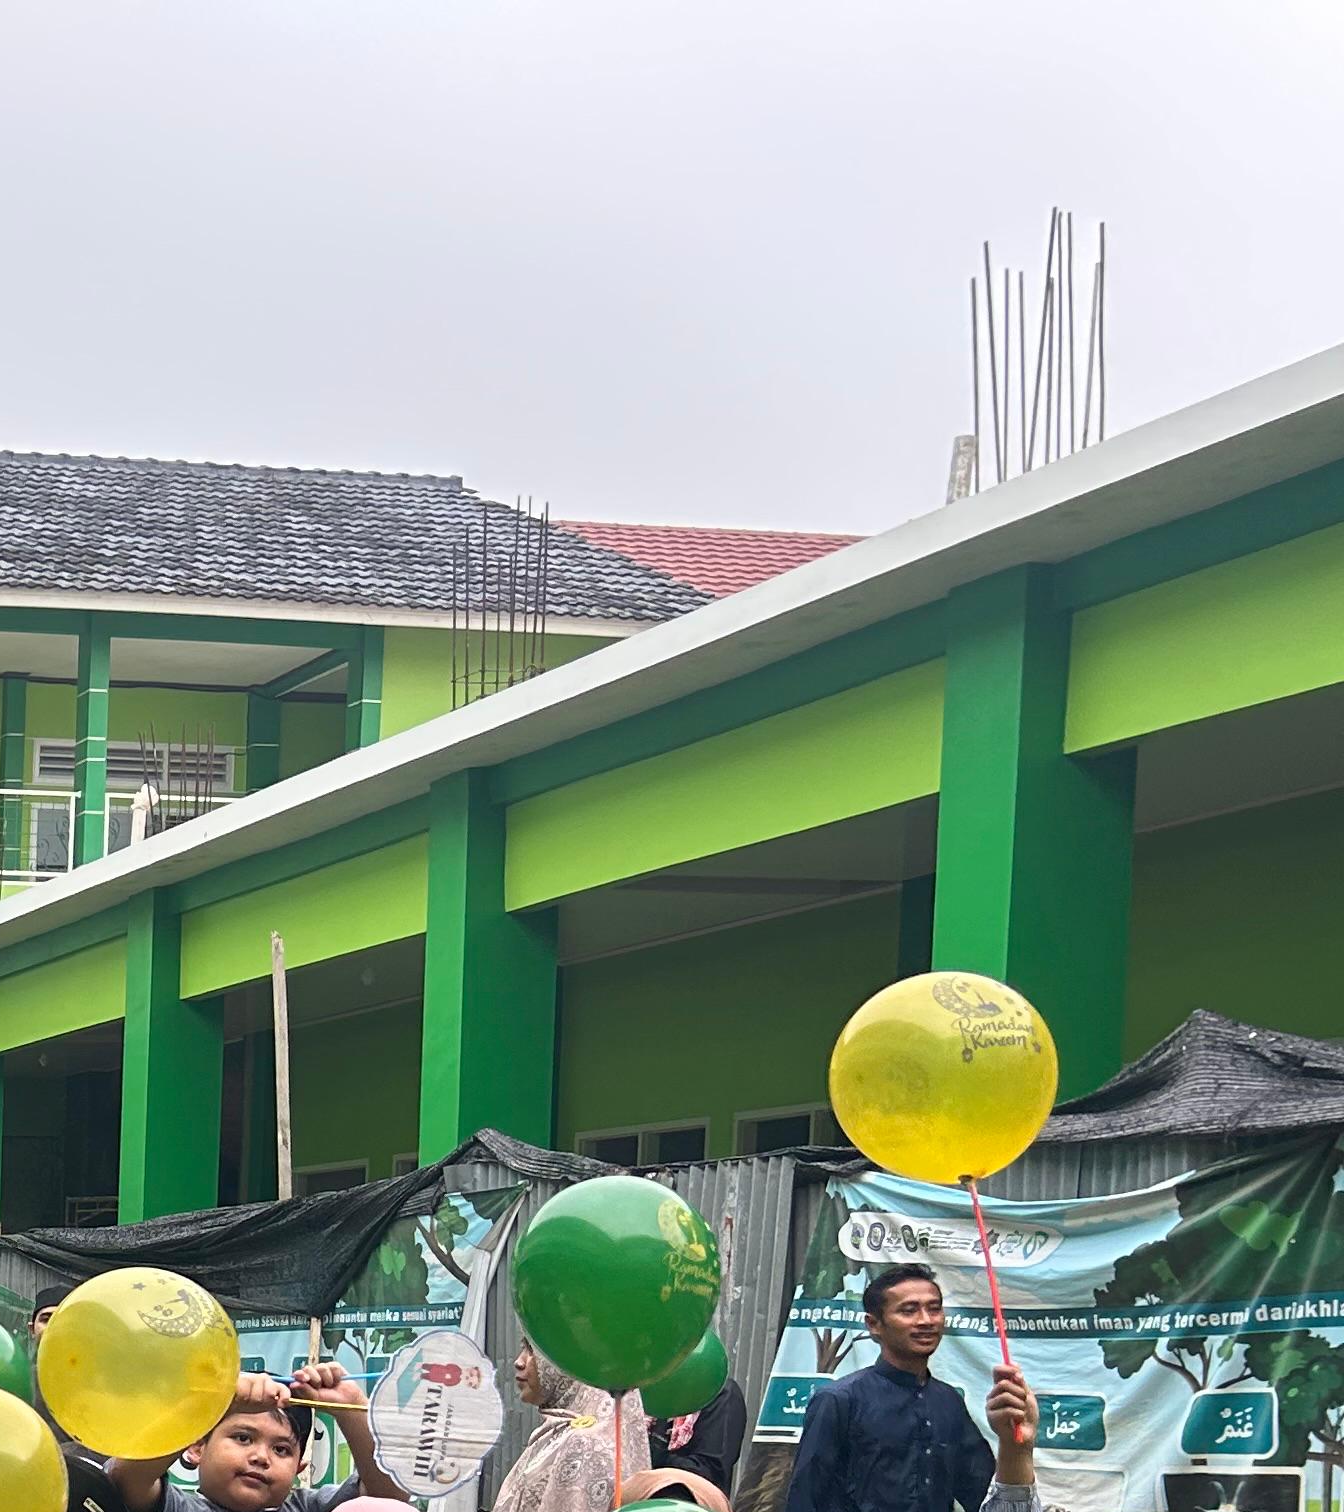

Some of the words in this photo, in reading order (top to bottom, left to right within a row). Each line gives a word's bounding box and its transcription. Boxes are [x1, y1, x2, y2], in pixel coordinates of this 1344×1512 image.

[951, 1016, 1035, 1036] Ramadan
[971, 1031, 1028, 1050] Kareem
[993, 1314, 1088, 1332] pmbentukan
[1093, 1313, 1134, 1330] iman
[1136, 1312, 1171, 1332] yang
